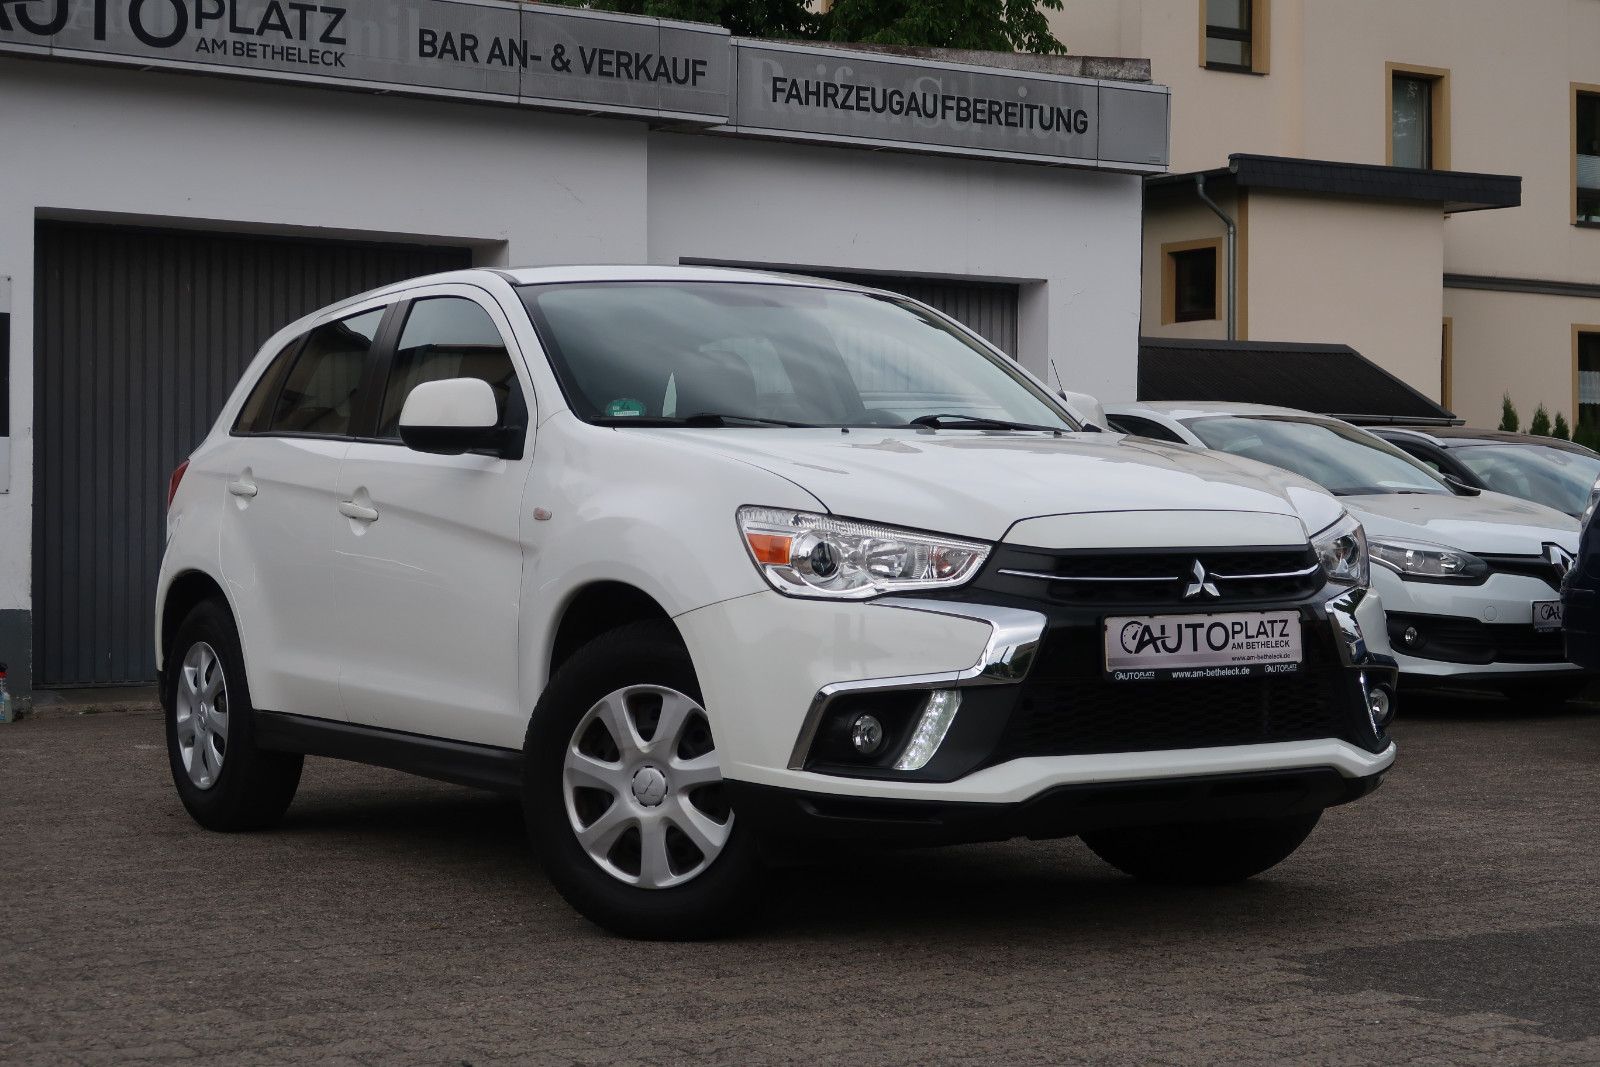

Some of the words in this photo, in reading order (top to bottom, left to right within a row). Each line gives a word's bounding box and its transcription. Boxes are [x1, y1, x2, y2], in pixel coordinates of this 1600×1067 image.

[195, 37, 228, 55] AM
[232, 41, 346, 68] BETHELECK
[418, 28, 479, 63] BAR
[486, 37, 542, 68] AN-
[550, 44, 572, 72] &
[578, 46, 708, 87] VERKAUF
[771, 76, 1089, 135] FAHRZEUGAUFBEREITUNG
[1231, 642, 1243, 650] AM
[1246, 639, 1290, 650] BETHELECK
[1171, 667, 1250, 679] www.am-betheleck.de
